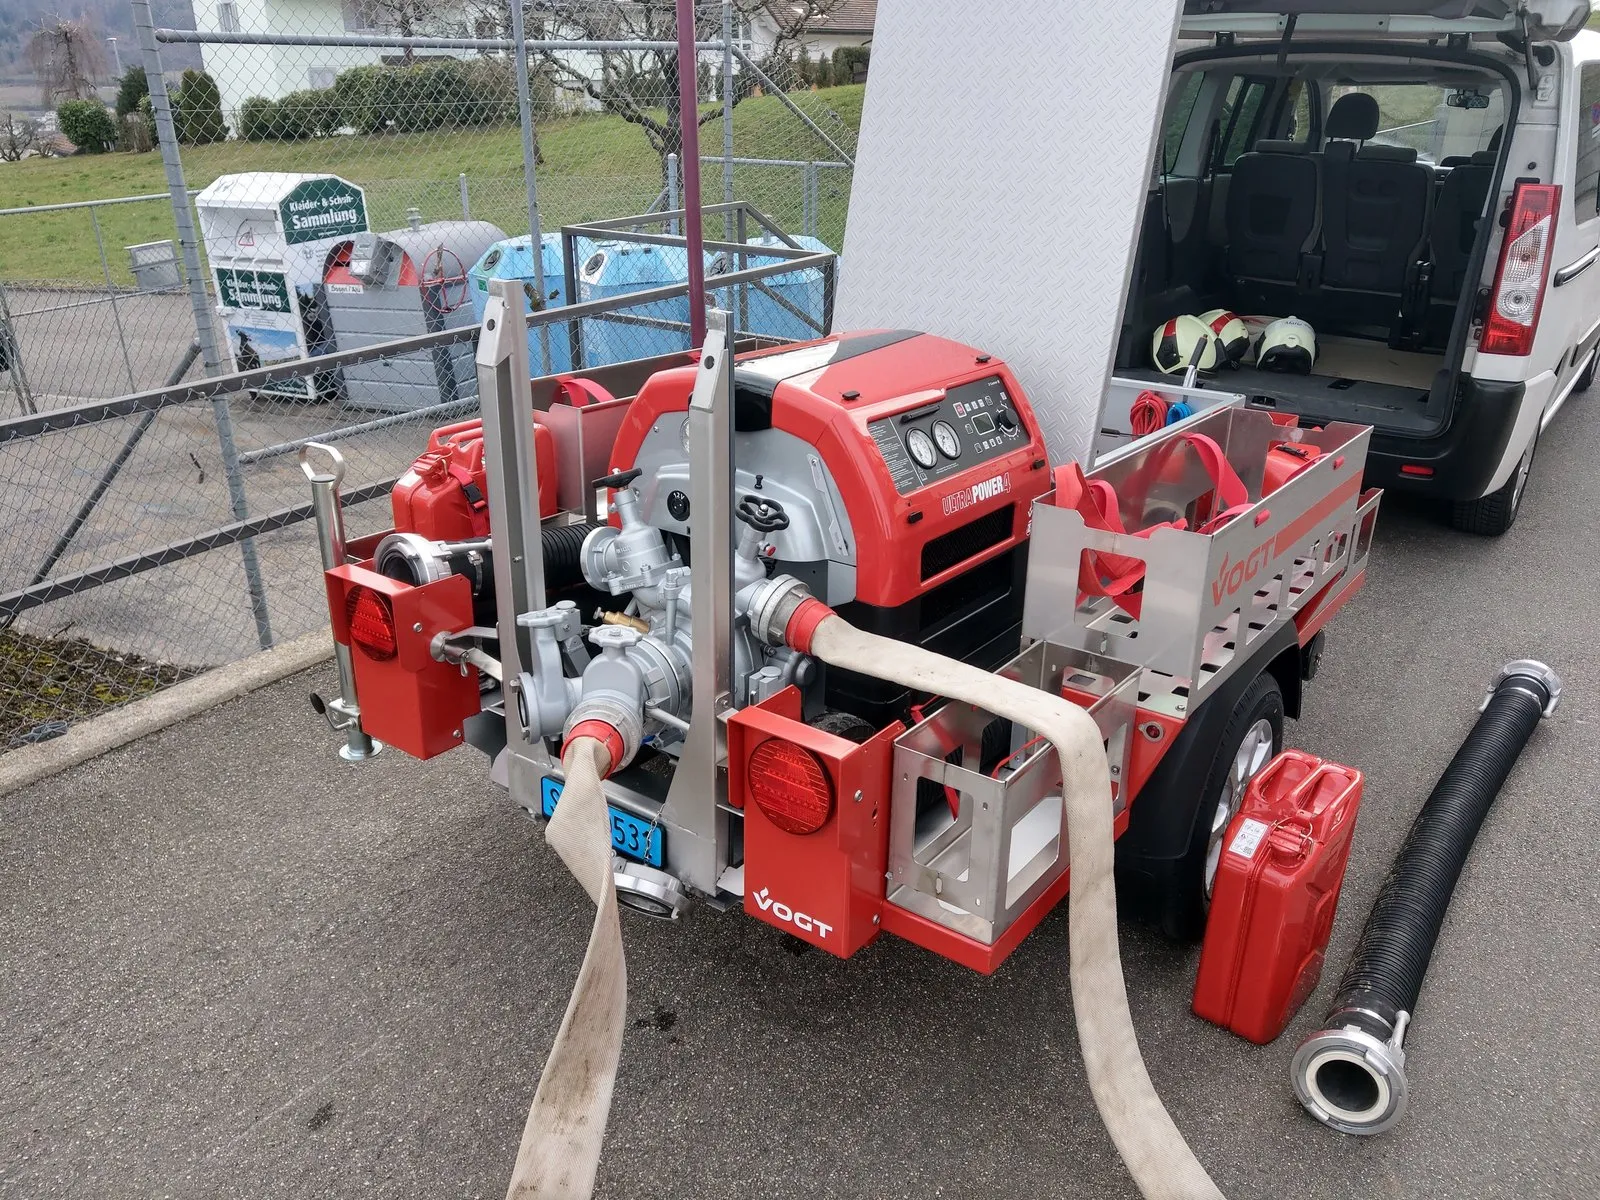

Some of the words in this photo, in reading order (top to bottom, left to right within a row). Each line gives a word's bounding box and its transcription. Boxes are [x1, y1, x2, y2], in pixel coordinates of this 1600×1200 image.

[289, 200, 320, 212] Kleider-
[321, 198, 328, 207] &
[292, 209, 357, 230] Sammlung
[1212, 537, 1275, 607] VOGT
[752, 887, 833, 939] VOGT
